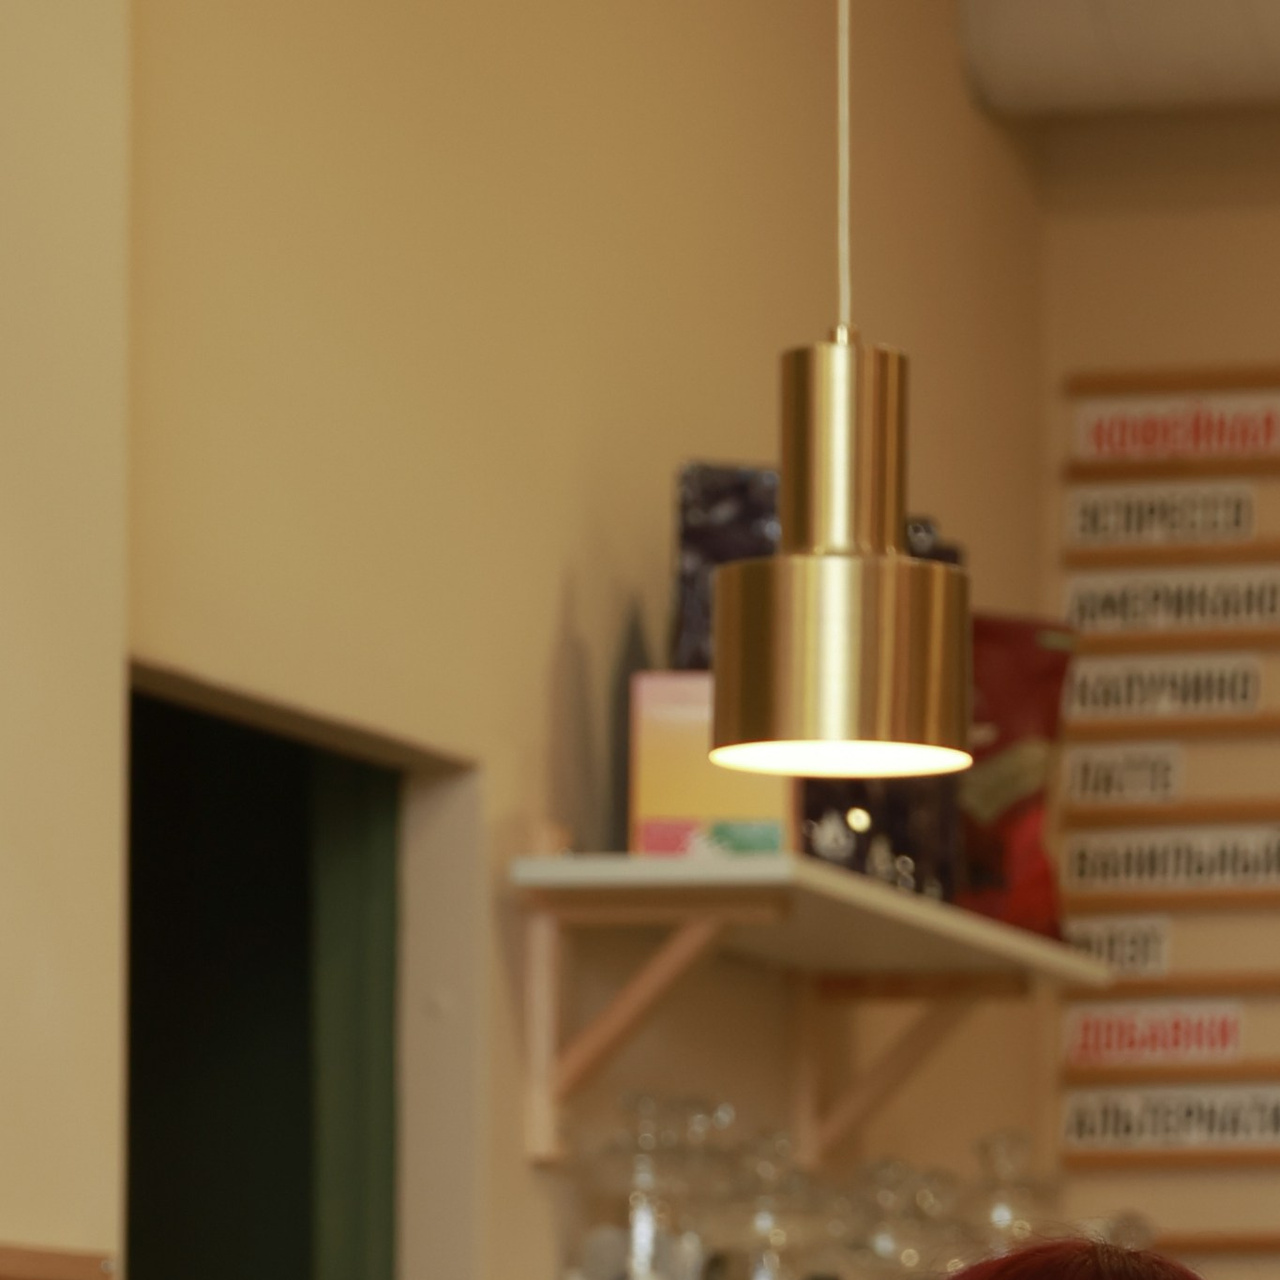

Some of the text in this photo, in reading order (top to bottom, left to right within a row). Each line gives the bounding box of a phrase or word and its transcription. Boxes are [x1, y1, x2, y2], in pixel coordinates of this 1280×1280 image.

[1088, 404, 1277, 456] КОФЕЙНАЯ
[1072, 494, 1251, 541] ЭСПРЕССО
[1072, 666, 1258, 714] КАПУЧИНО
[1069, 755, 1179, 800] ЛАТТЕ
[1071, 1013, 1237, 1062] ДОБАВКИ
